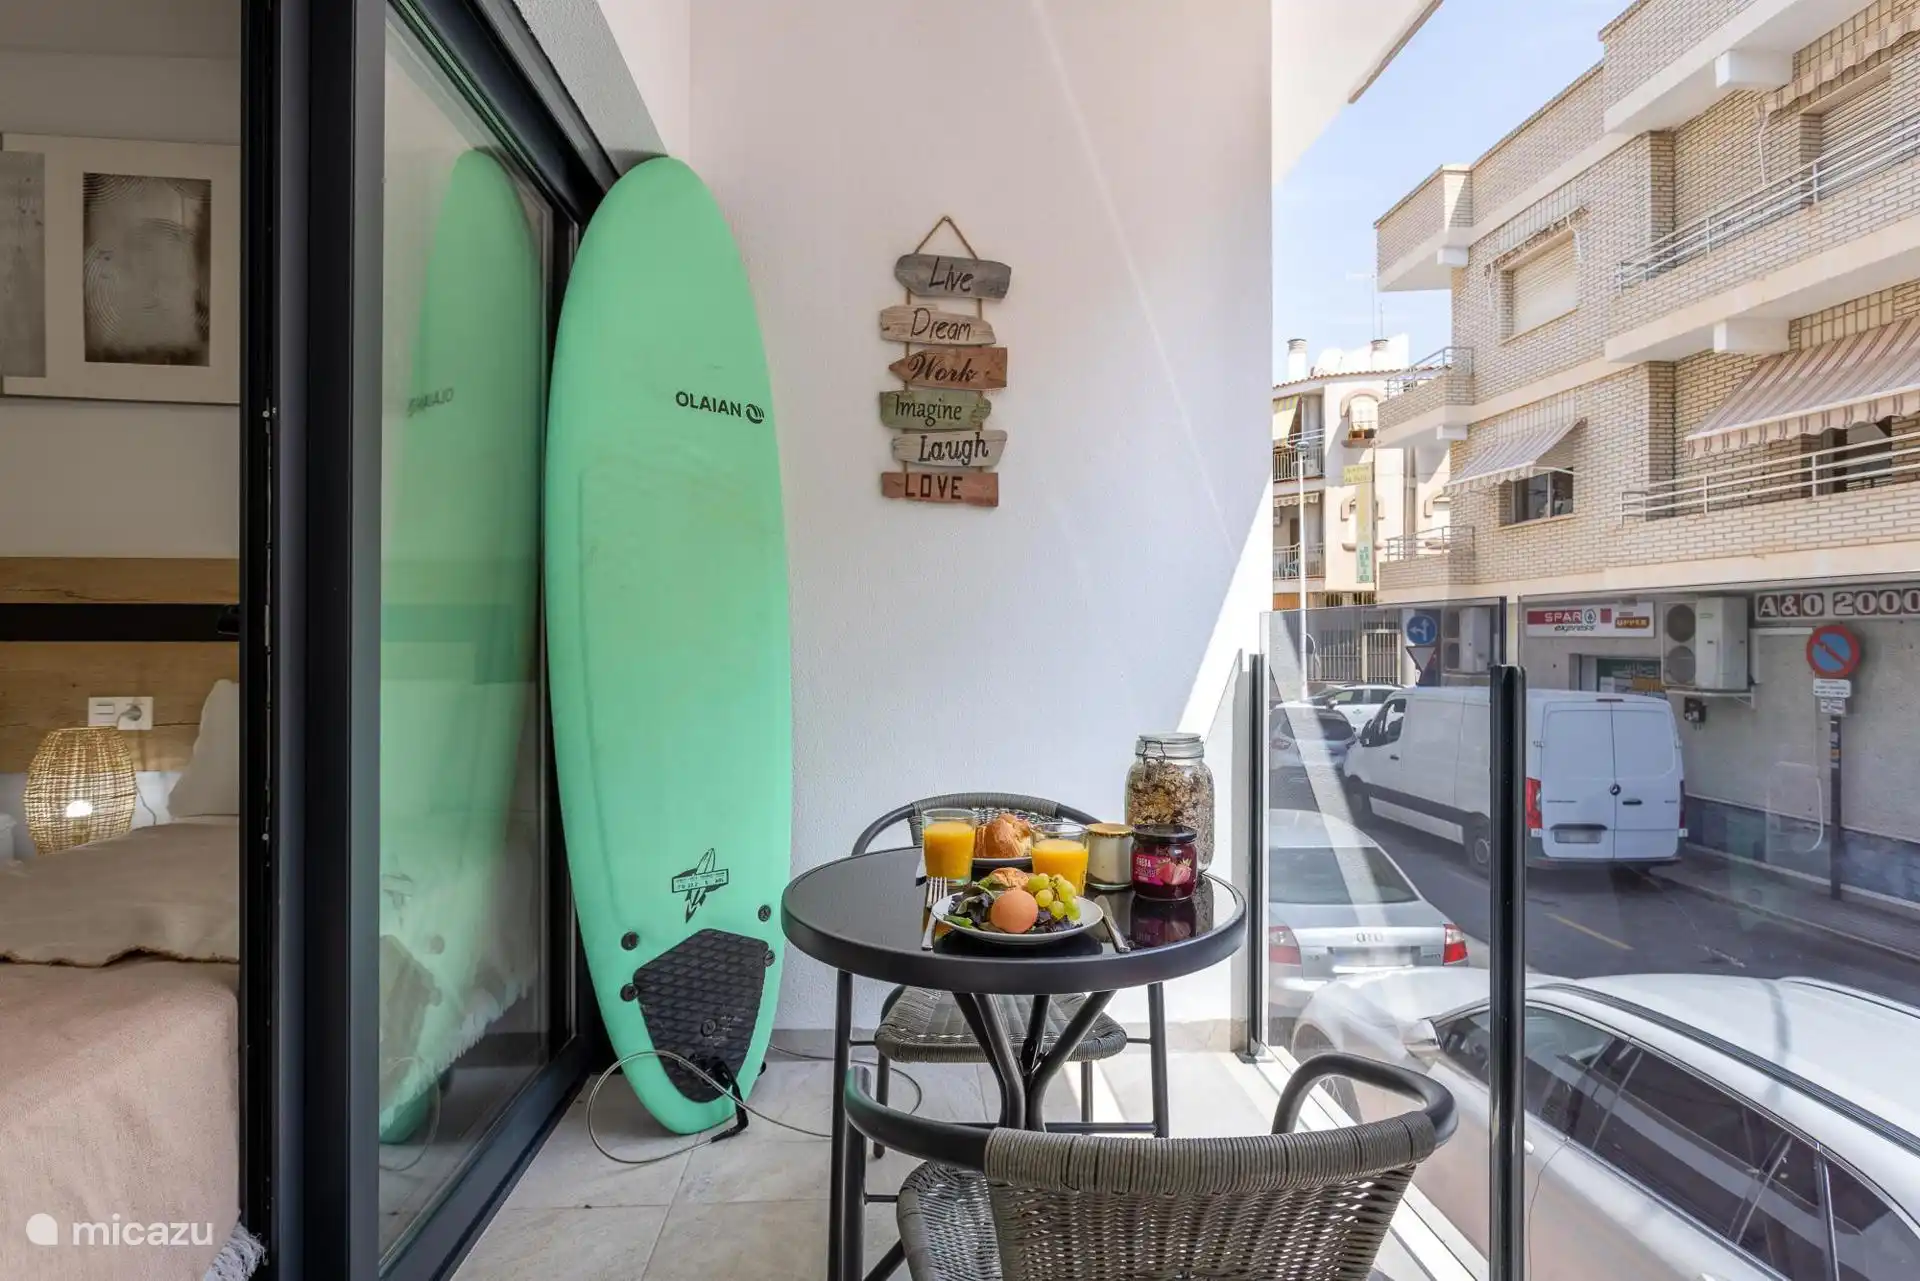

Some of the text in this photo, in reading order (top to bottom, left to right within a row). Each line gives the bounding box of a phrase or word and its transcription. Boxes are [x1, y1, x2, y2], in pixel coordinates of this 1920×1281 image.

[928, 257, 975, 292] Live
[910, 307, 972, 342] Dream
[907, 353, 977, 382] Work
[675, 391, 742, 418] OLAIAN
[895, 394, 963, 427] Imagine
[918, 431, 989, 466] Laugh
[904, 474, 964, 500] LOVE
[1544, 611, 1581, 623] SPAR
[1833, 590, 1920, 615] 2000
